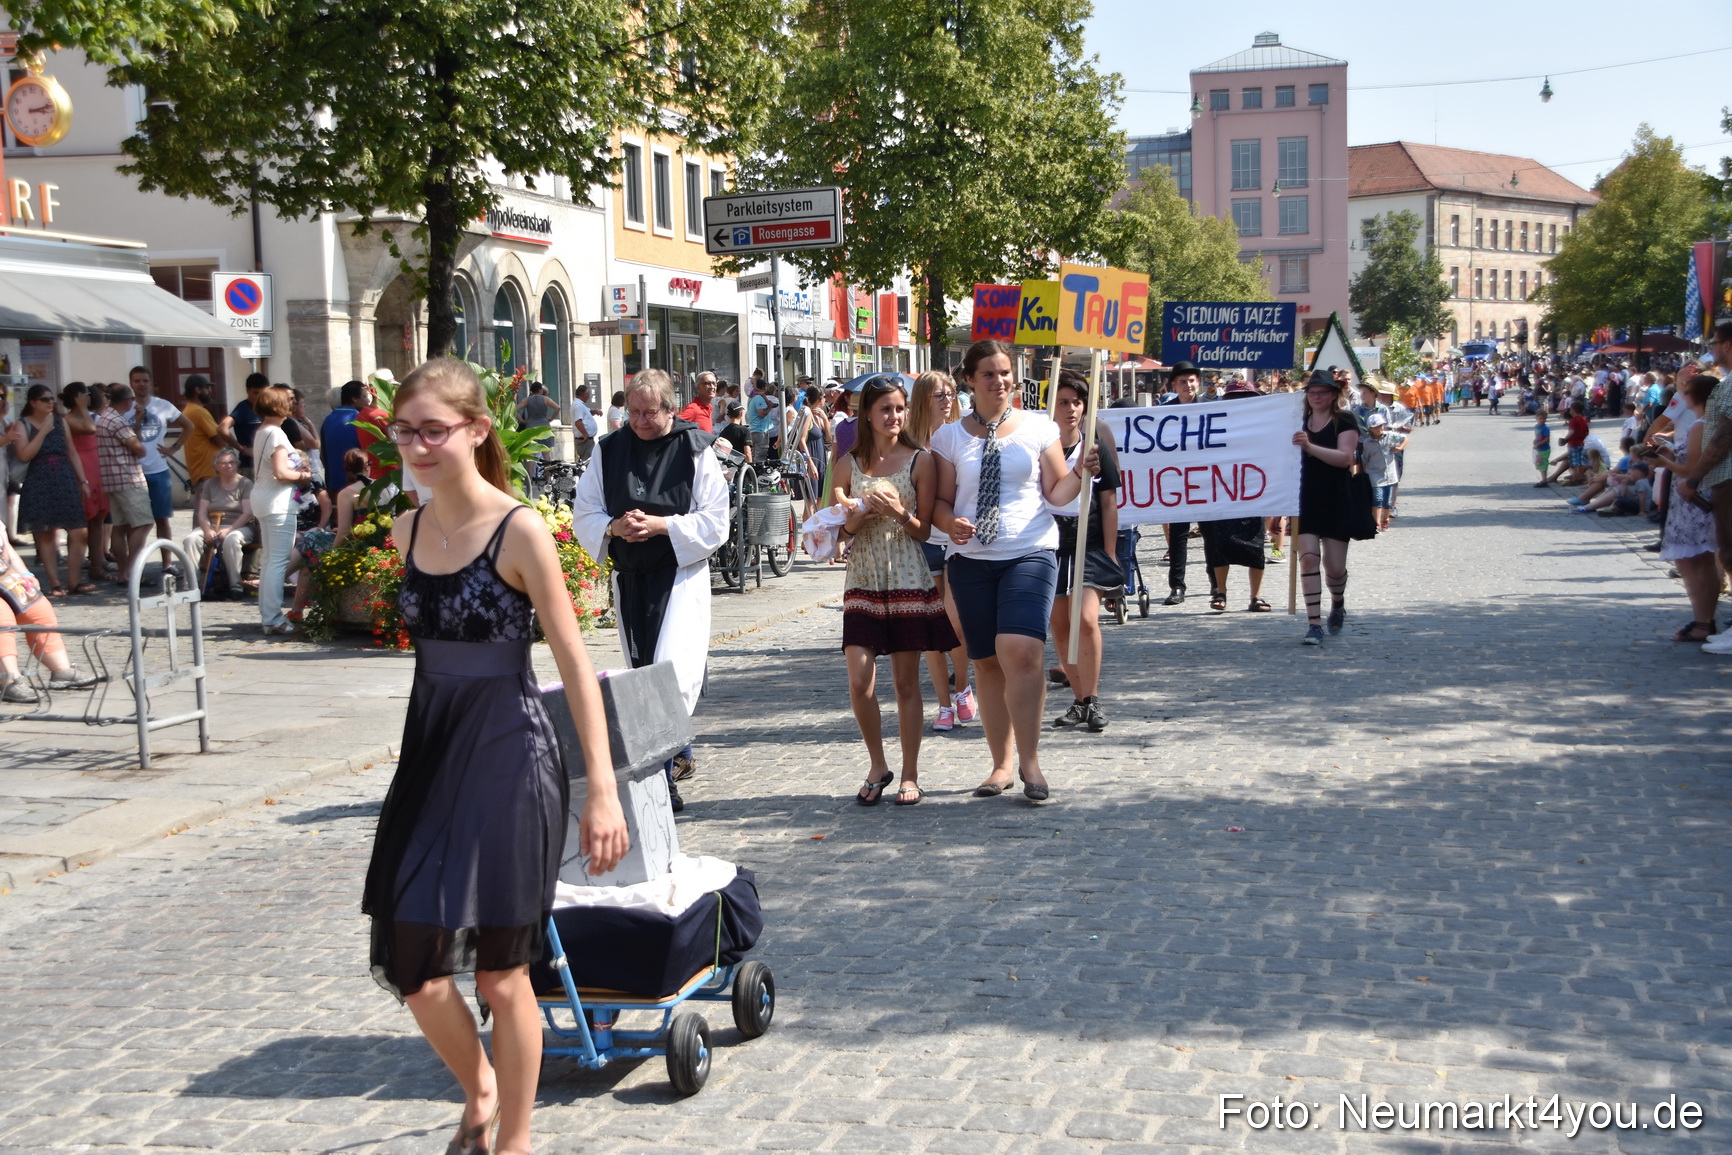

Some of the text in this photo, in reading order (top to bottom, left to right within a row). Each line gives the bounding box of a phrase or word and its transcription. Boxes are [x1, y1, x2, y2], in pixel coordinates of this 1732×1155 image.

[8, 179, 60, 222] RF
[727, 199, 813, 217] Parkleitsystem
[758, 226, 815, 240] Rosengasse
[739, 276, 769, 289] Rosengasse
[976, 288, 1020, 308] KONF
[230, 318, 259, 328] ZONE
[1173, 304, 1282, 325] SIEDLUNG TAIZÉ
[977, 316, 1017, 336] MAT
[1171, 327, 1289, 343] Verband Christlicher
[1190, 344, 1262, 363] Pfadfinder
[1116, 463, 1266, 510] JUGEND
